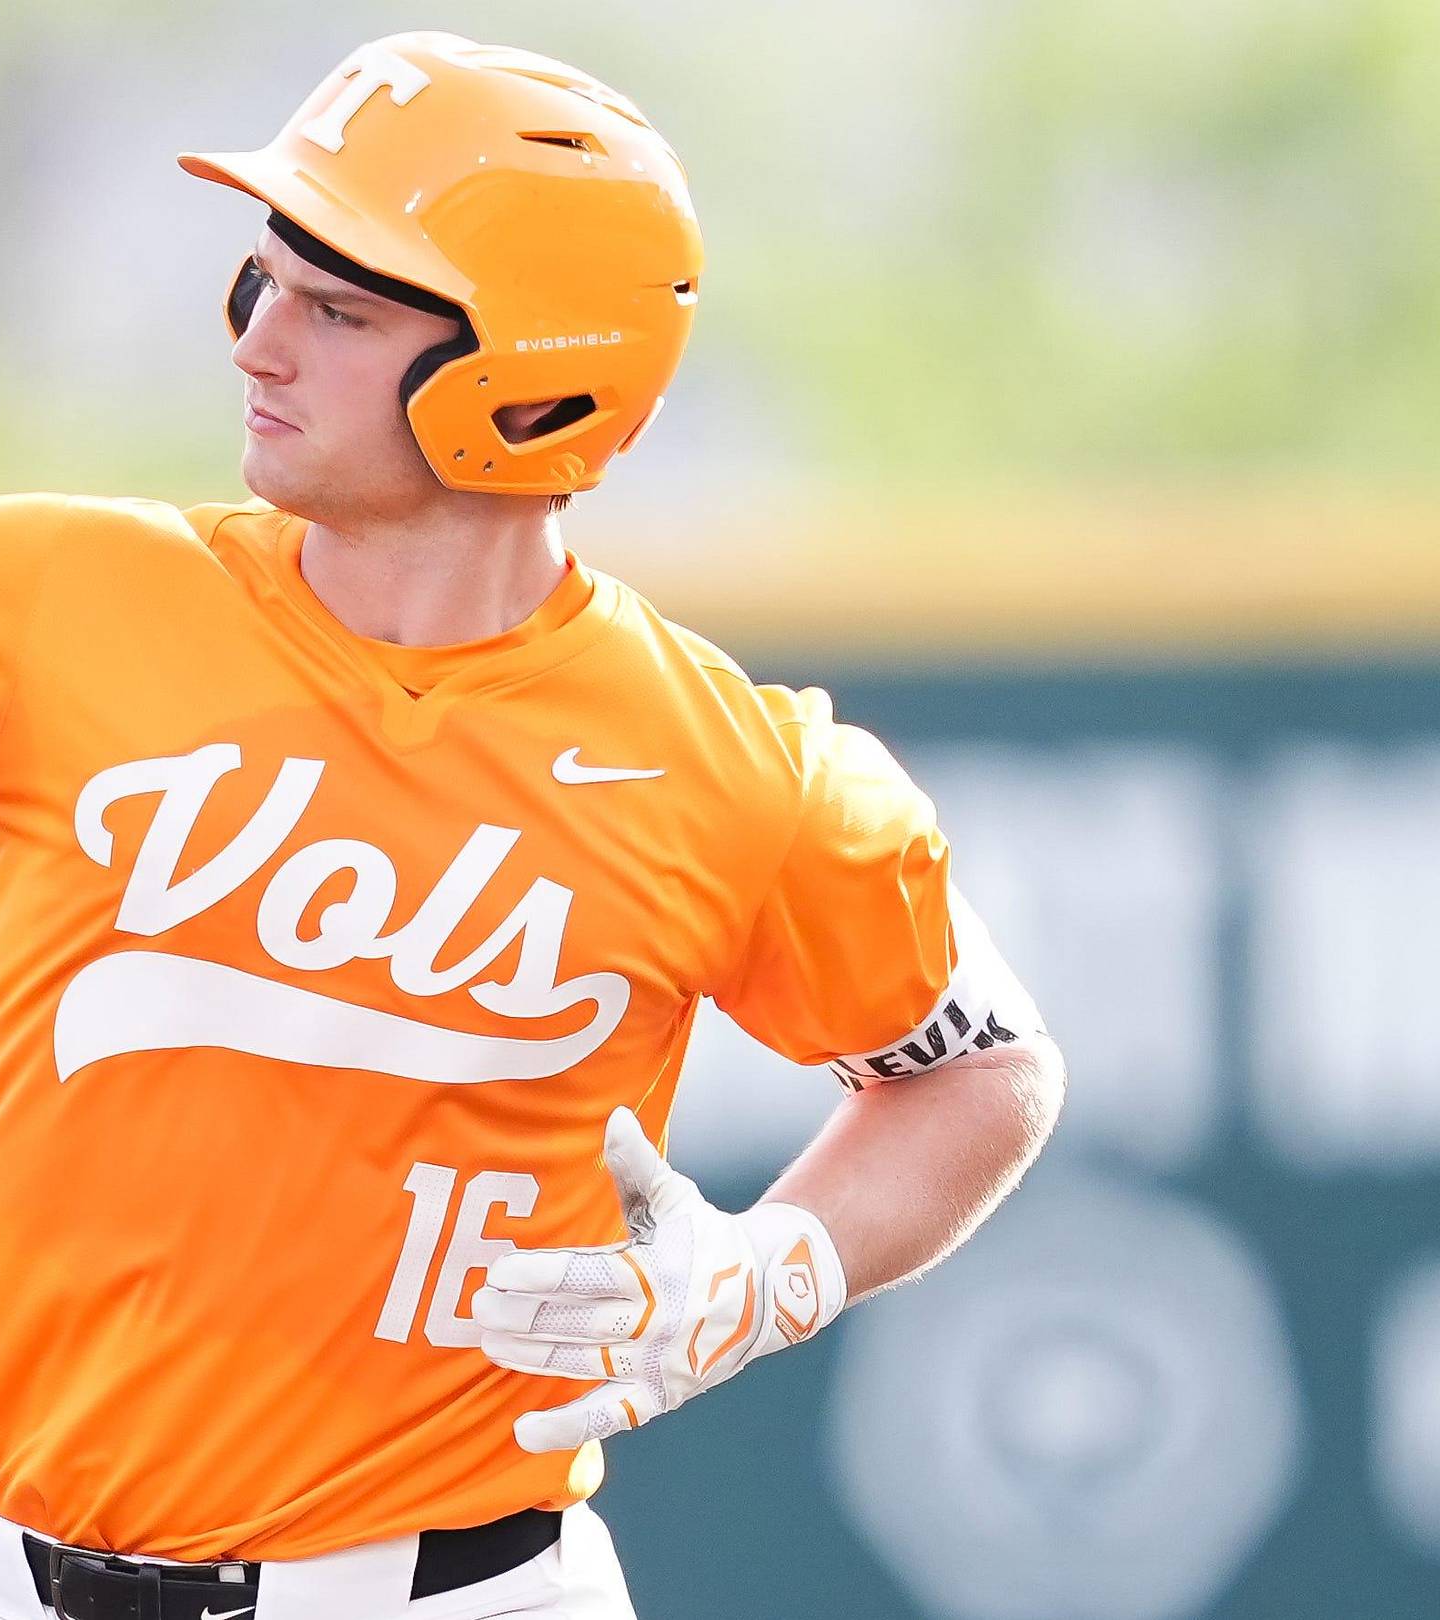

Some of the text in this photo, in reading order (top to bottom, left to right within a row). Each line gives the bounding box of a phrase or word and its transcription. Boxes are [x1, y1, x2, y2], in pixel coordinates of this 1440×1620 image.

[301, 44, 432, 155] T
[515, 331, 621, 352] EVOSHIELD
[73, 743, 575, 1019] Vols
[373, 1161, 541, 1349] 16
